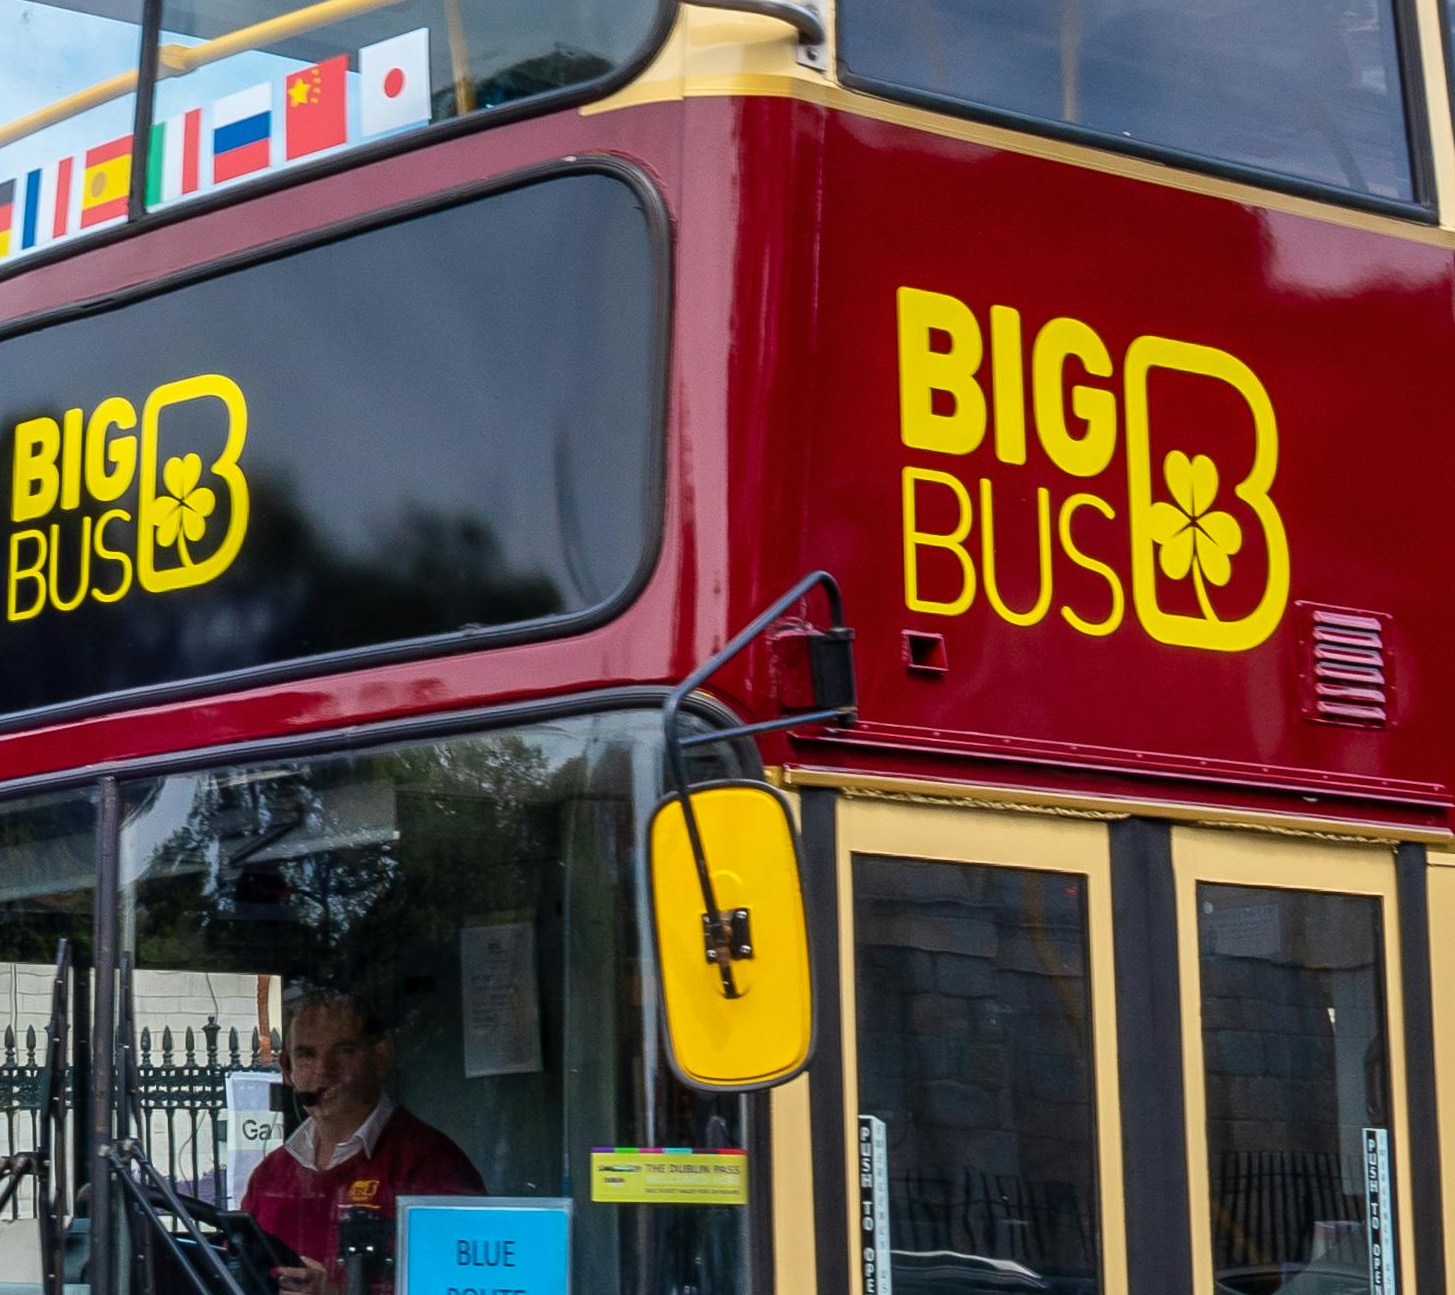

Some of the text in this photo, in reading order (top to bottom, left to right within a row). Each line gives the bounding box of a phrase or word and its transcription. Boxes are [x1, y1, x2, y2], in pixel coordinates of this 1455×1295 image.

[896, 286, 1117, 477] BIG
[11, 396, 138, 522] BIG
[7, 509, 133, 622] BUS
[902, 466, 1125, 636] BUS
[644, 1164, 666, 1173] THE
[669, 1164, 710, 1174] DUBLIN
[713, 1165, 741, 1175] PASS
[860, 1126, 874, 1188] PUSH
[1367, 1138, 1380, 1194] PUSH
[862, 1201, 875, 1231] TO
[1370, 1202, 1381, 1230] TO
[457, 1240, 515, 1268] BLUE
